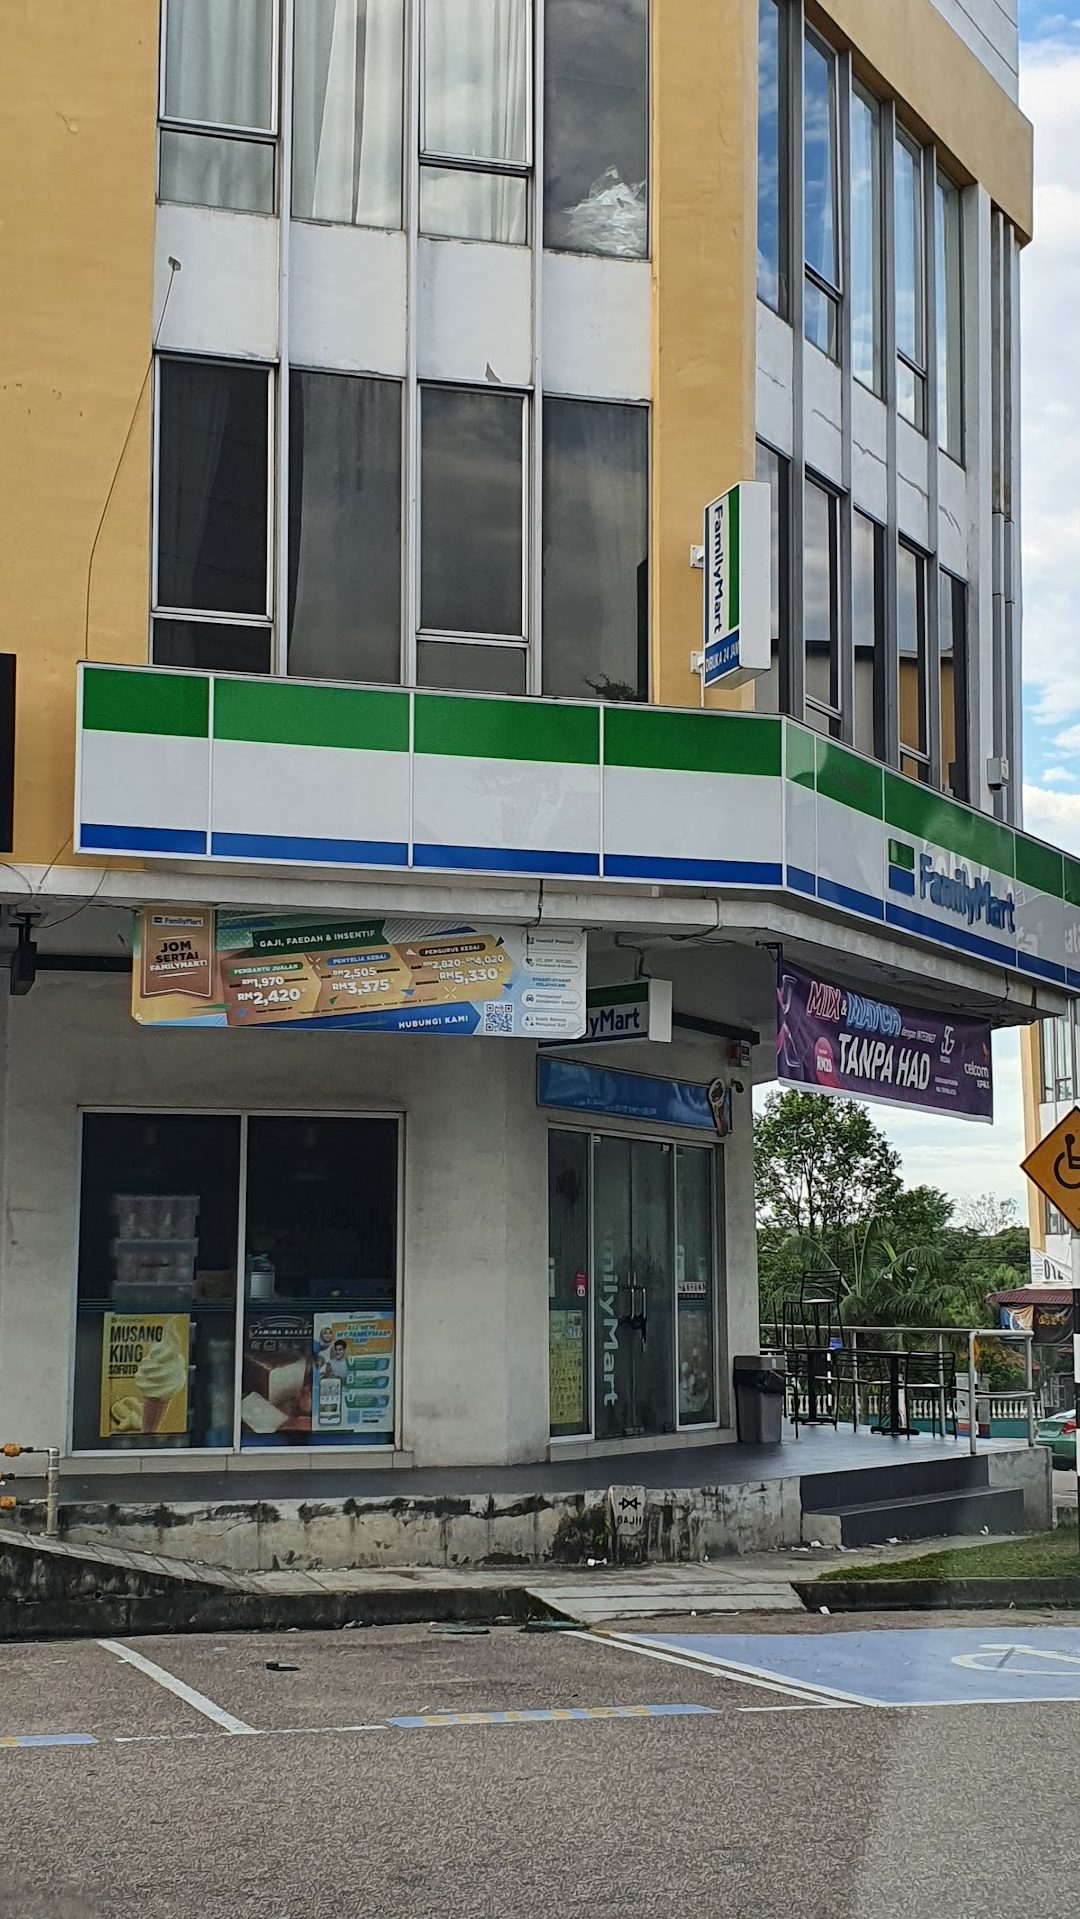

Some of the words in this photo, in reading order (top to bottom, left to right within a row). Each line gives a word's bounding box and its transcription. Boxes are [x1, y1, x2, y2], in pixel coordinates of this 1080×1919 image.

[713, 504, 724, 635] FamilyMart
[920, 853, 1015, 934] FamilyMart
[160, 940, 191, 953] JOM
[260, 939, 284, 948] GAJI,
[286, 934, 323, 945] FAEDAH
[334, 929, 375, 940] INSENTIF
[155, 951, 199, 963] SERTAI
[807, 980, 841, 1021] MIX
[840, 999, 848, 1016] &
[846, 991, 901, 1037] MATCH
[398, 1018, 442, 1030] HUBUNGI
[444, 1015, 469, 1024] KAMI
[838, 1033, 895, 1084] TANPA
[895, 1047, 931, 1090] HAD
[963, 1060, 989, 1078] celcom
[110, 1325, 163, 1343] MUSANG
[109, 1344, 143, 1363] KING
